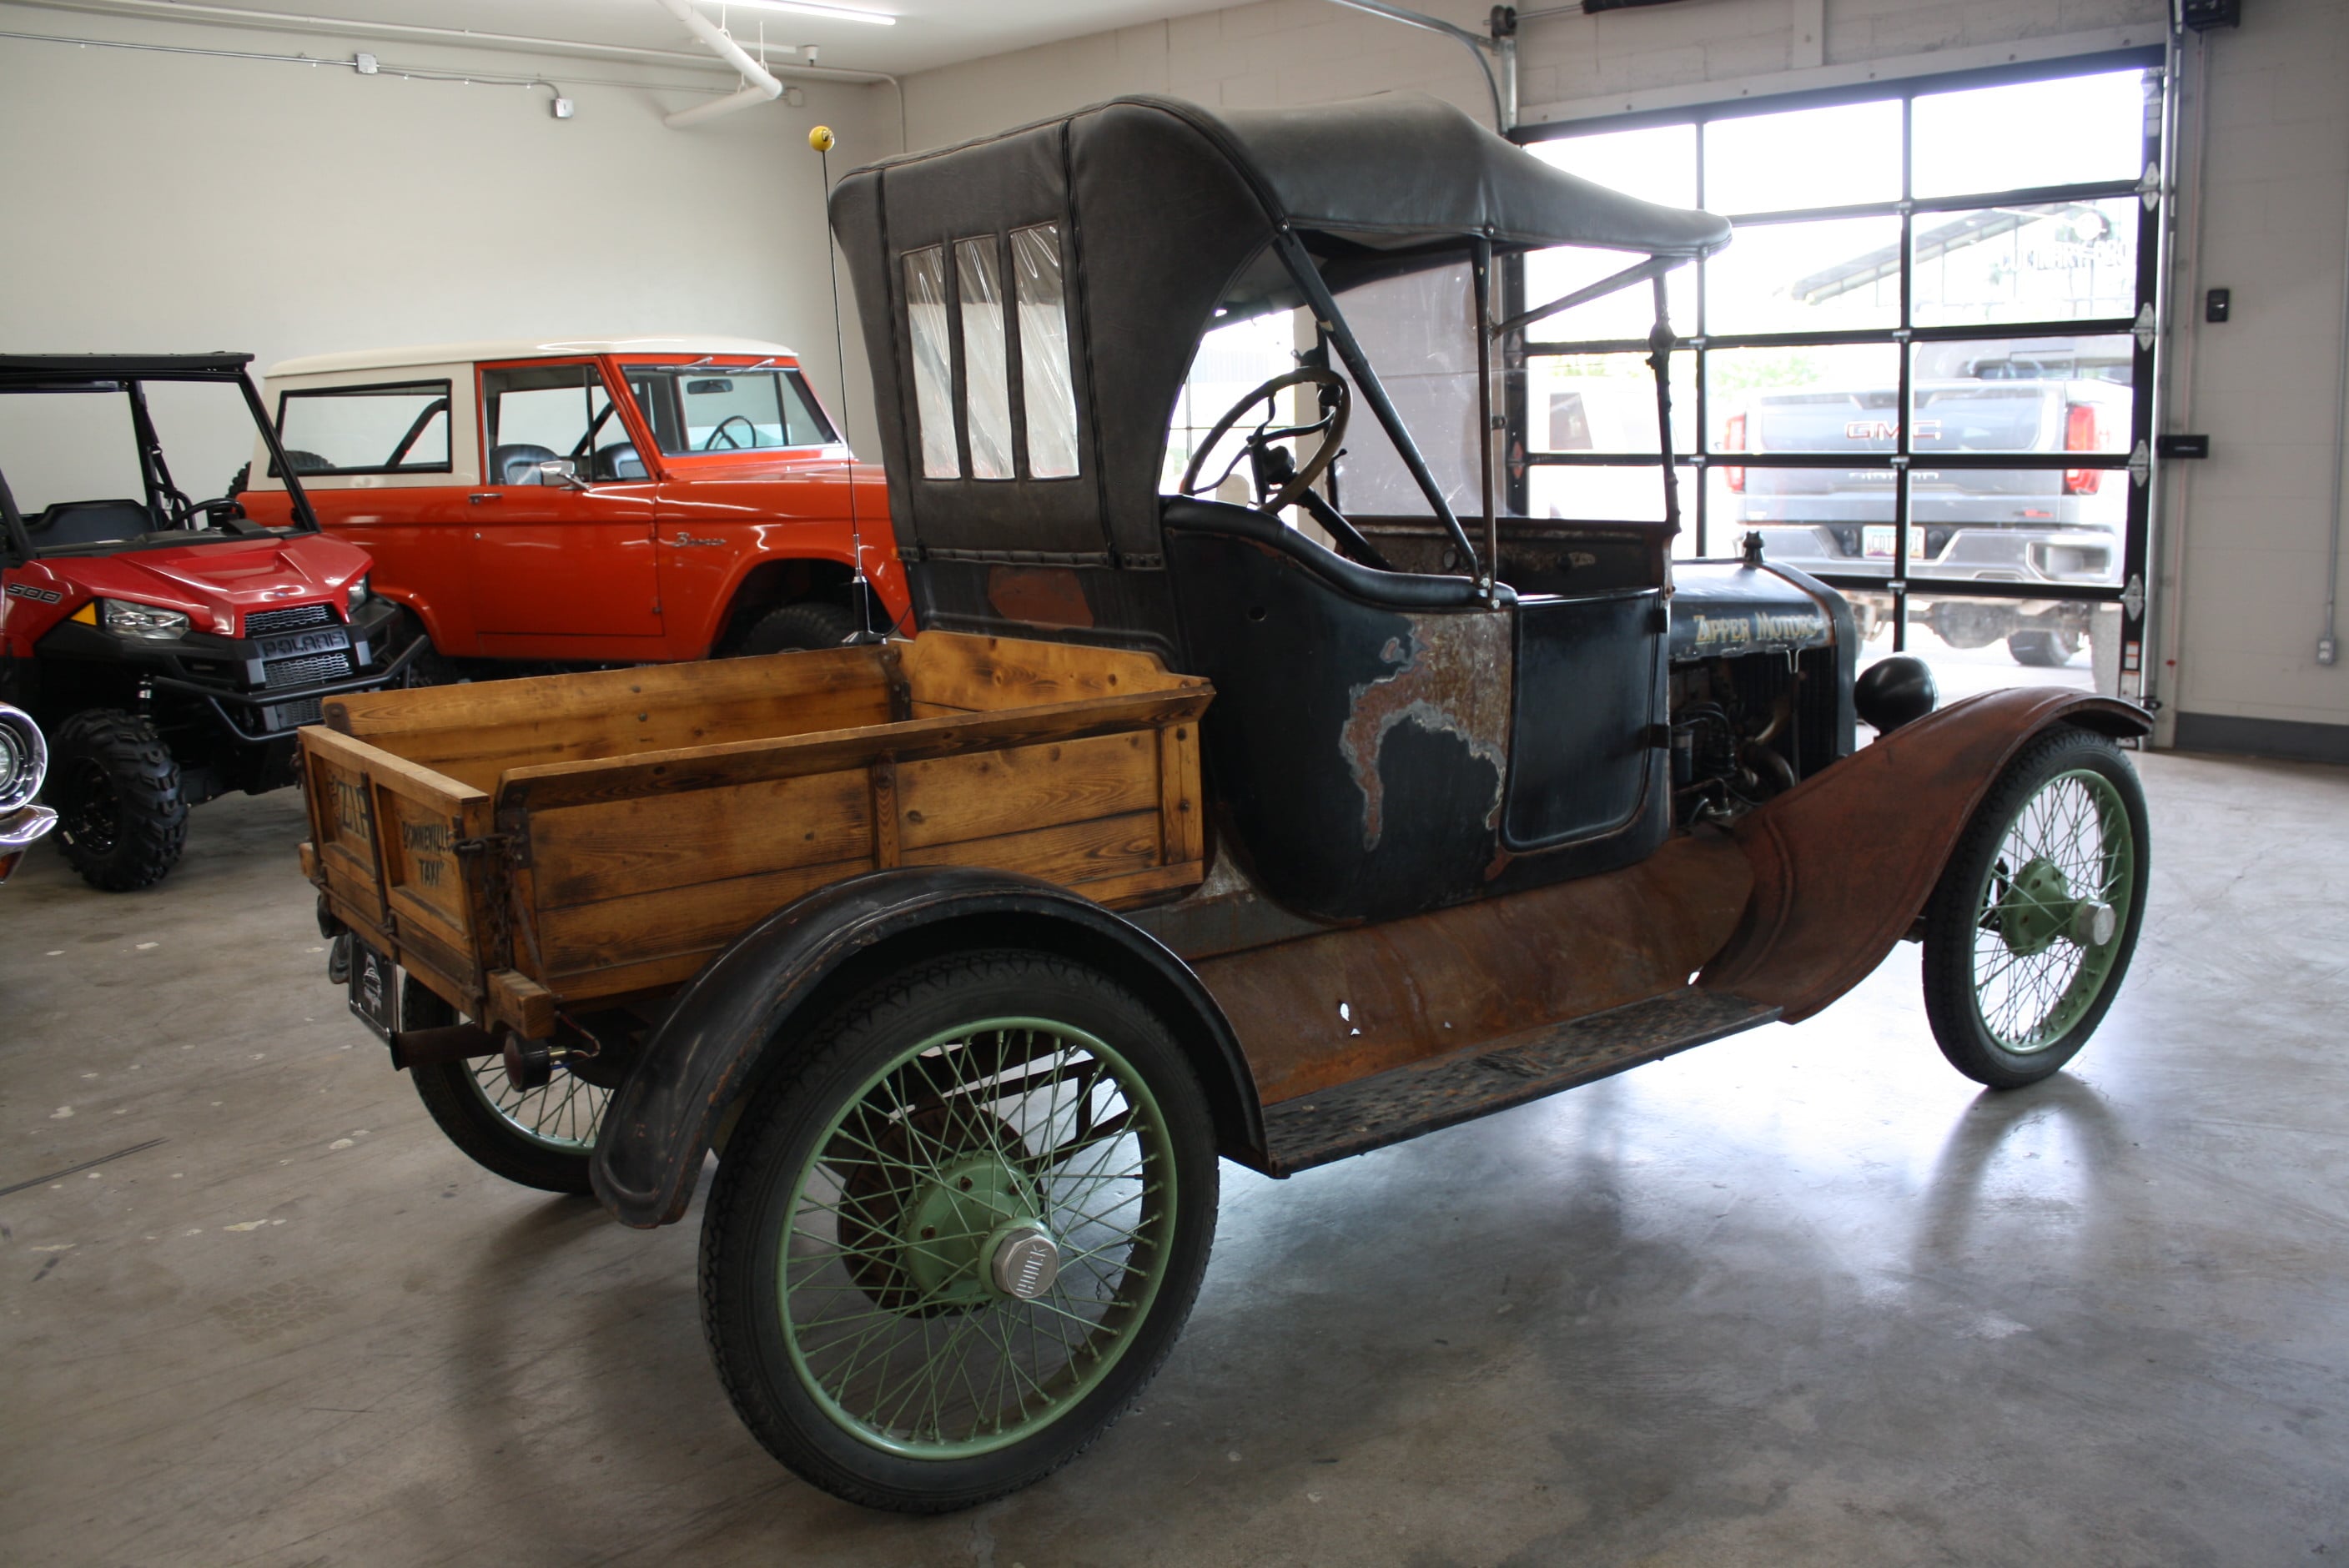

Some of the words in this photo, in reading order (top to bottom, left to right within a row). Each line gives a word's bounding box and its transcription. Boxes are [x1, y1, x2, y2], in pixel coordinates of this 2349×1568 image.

[1845, 420, 1942, 440] GMC
[6, 582, 63, 604] 500
[1693, 614, 1751, 645] ZIPPER
[1755, 611, 1818, 641] MOTORS
[261, 631, 346, 656] POLARIS
